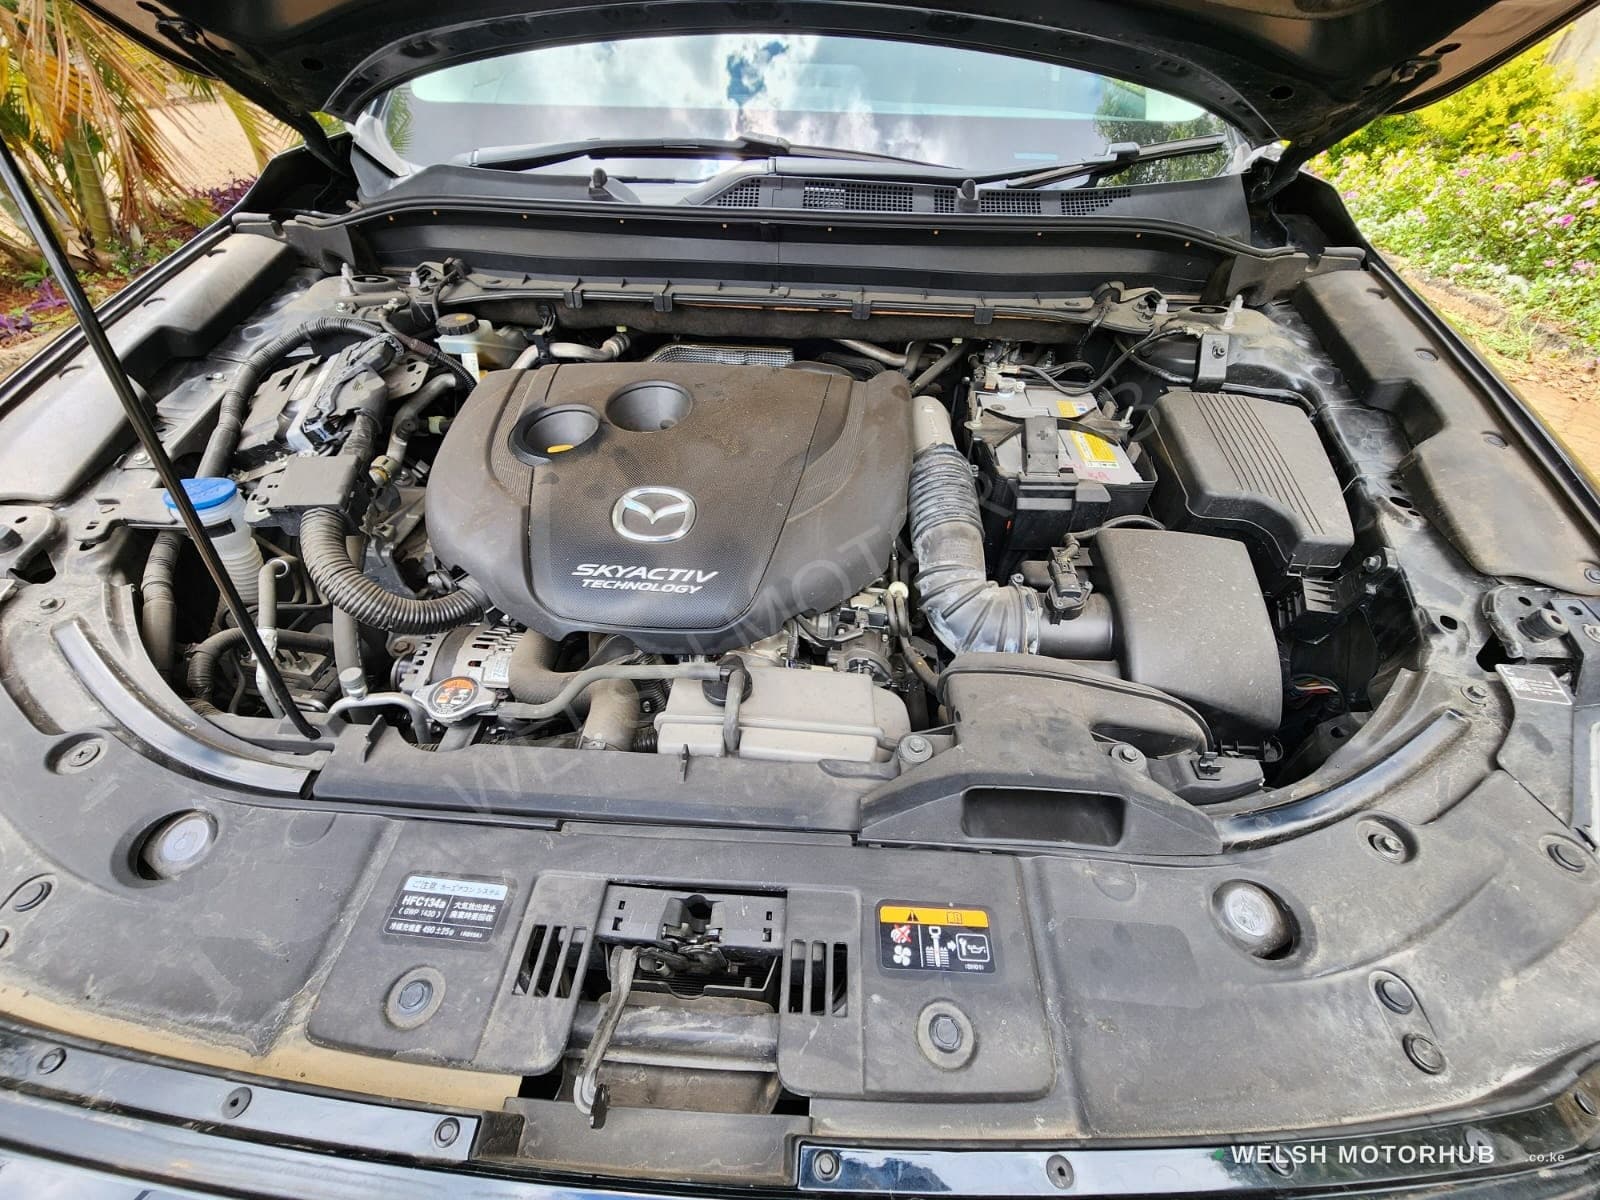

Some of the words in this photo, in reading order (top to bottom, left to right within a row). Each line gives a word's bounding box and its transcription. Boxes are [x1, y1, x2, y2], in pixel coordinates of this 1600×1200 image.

[572, 563, 719, 583] SKYACTIV
[581, 579, 703, 594] TECHNOLOGY
[402, 895, 446, 909] HFC134a
